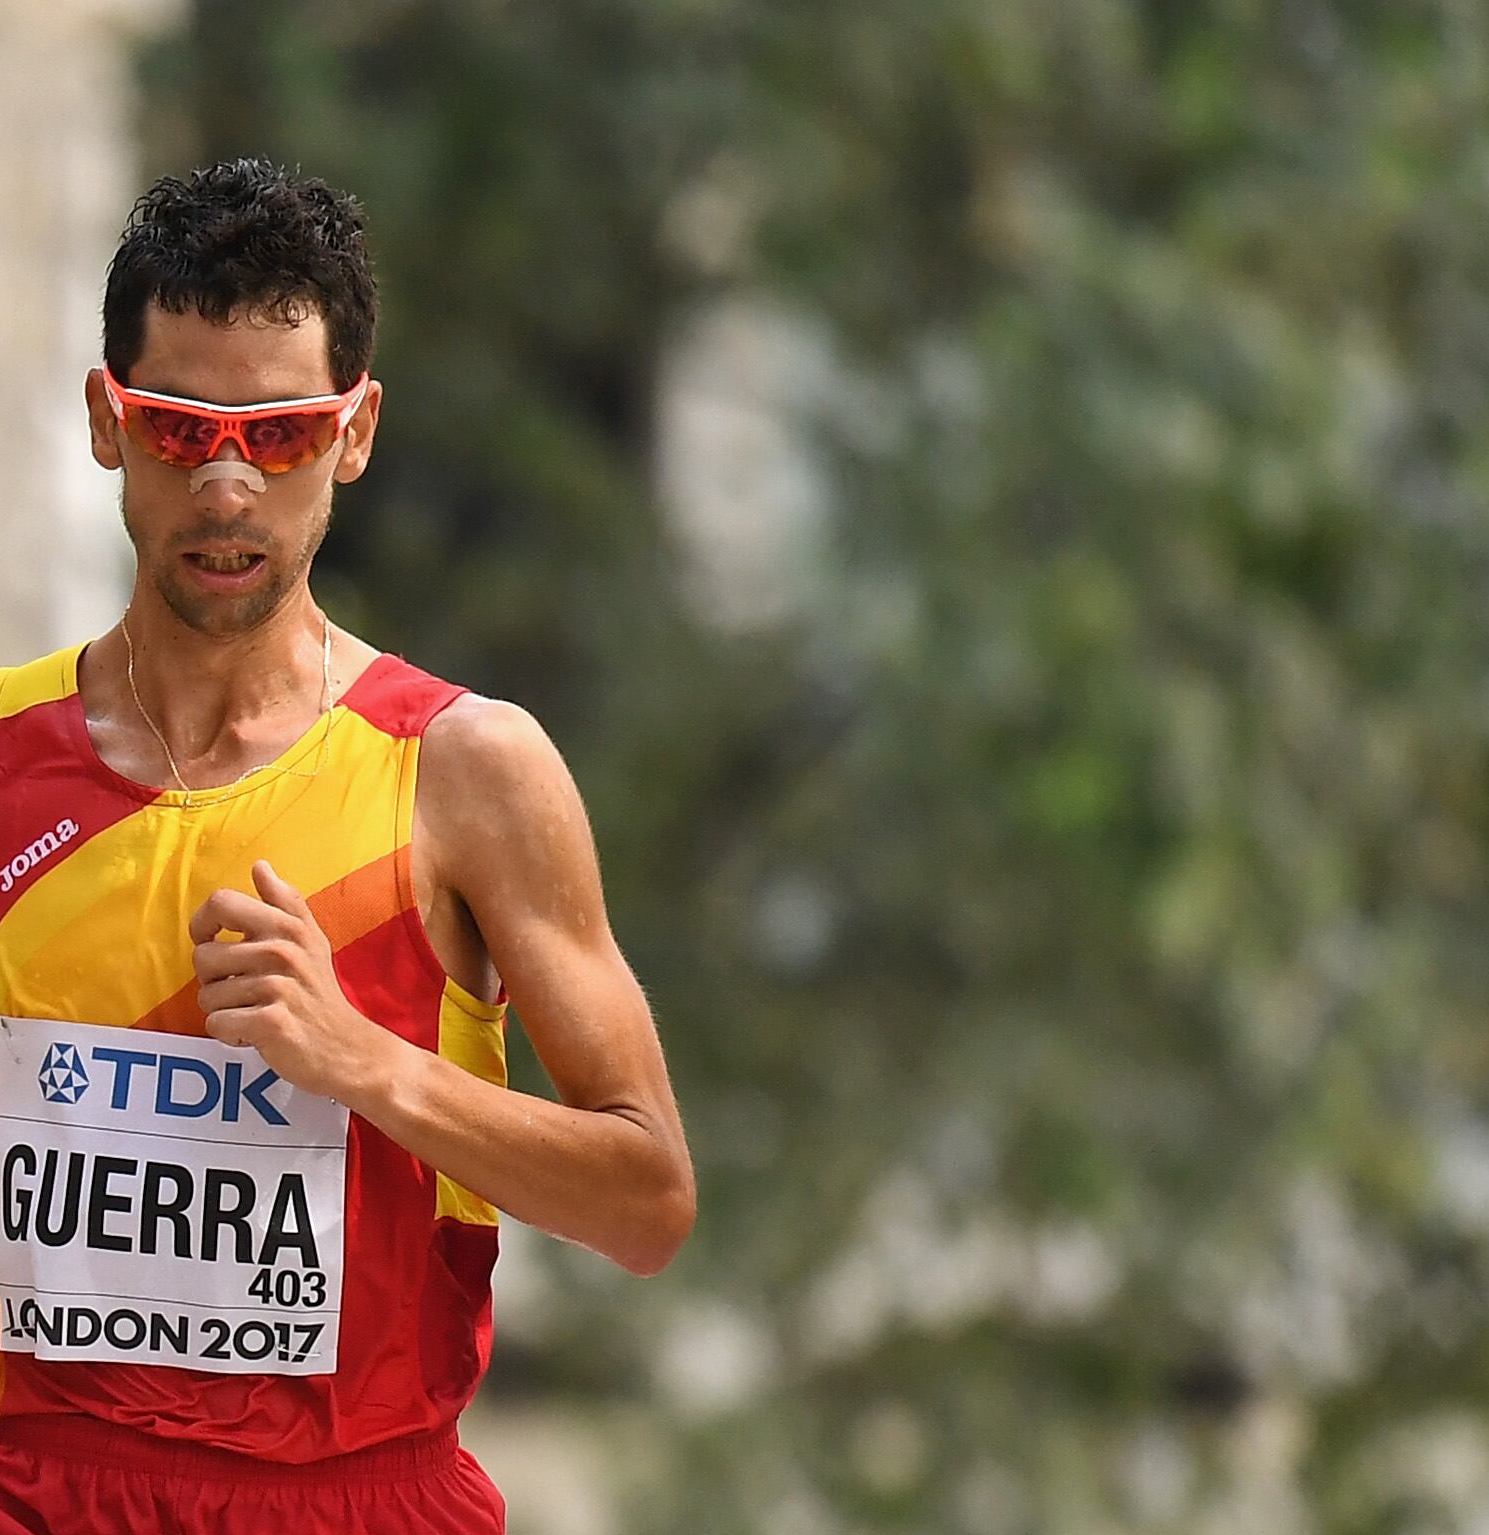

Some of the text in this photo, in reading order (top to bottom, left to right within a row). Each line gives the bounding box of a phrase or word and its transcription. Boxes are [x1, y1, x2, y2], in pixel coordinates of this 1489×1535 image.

[91, 1045, 291, 1126] TDK
[2, 1143, 320, 1269] GUERRA
[247, 1269, 327, 1307] 403
[2, 1297, 326, 1363] LONDON 2017
